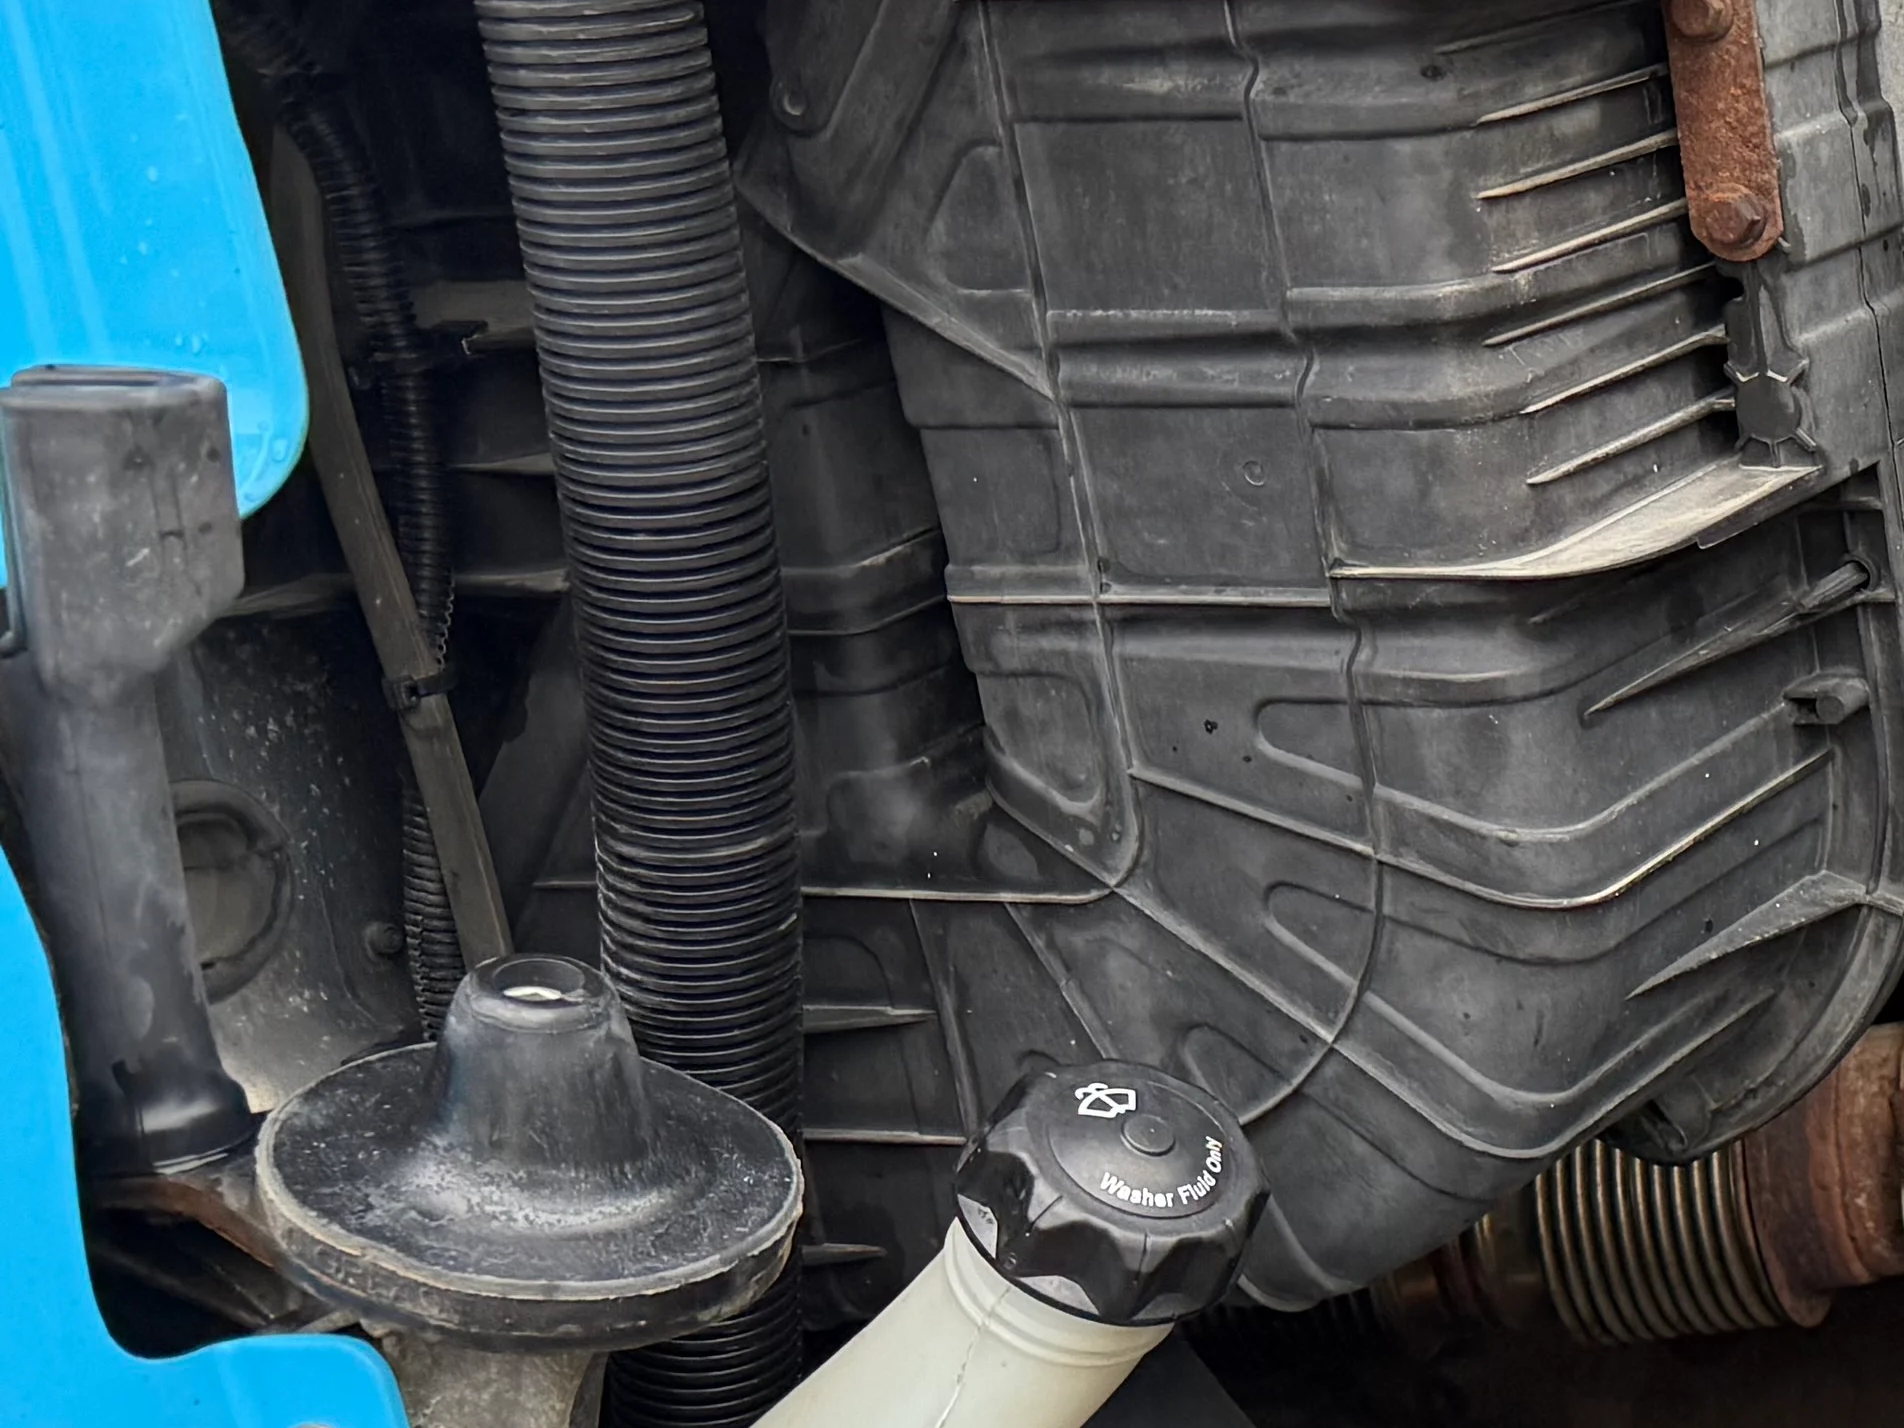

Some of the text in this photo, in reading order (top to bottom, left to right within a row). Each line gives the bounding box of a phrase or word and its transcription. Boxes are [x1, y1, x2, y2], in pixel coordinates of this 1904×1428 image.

[1100, 1135, 1223, 1208] Washer Fluid Only
